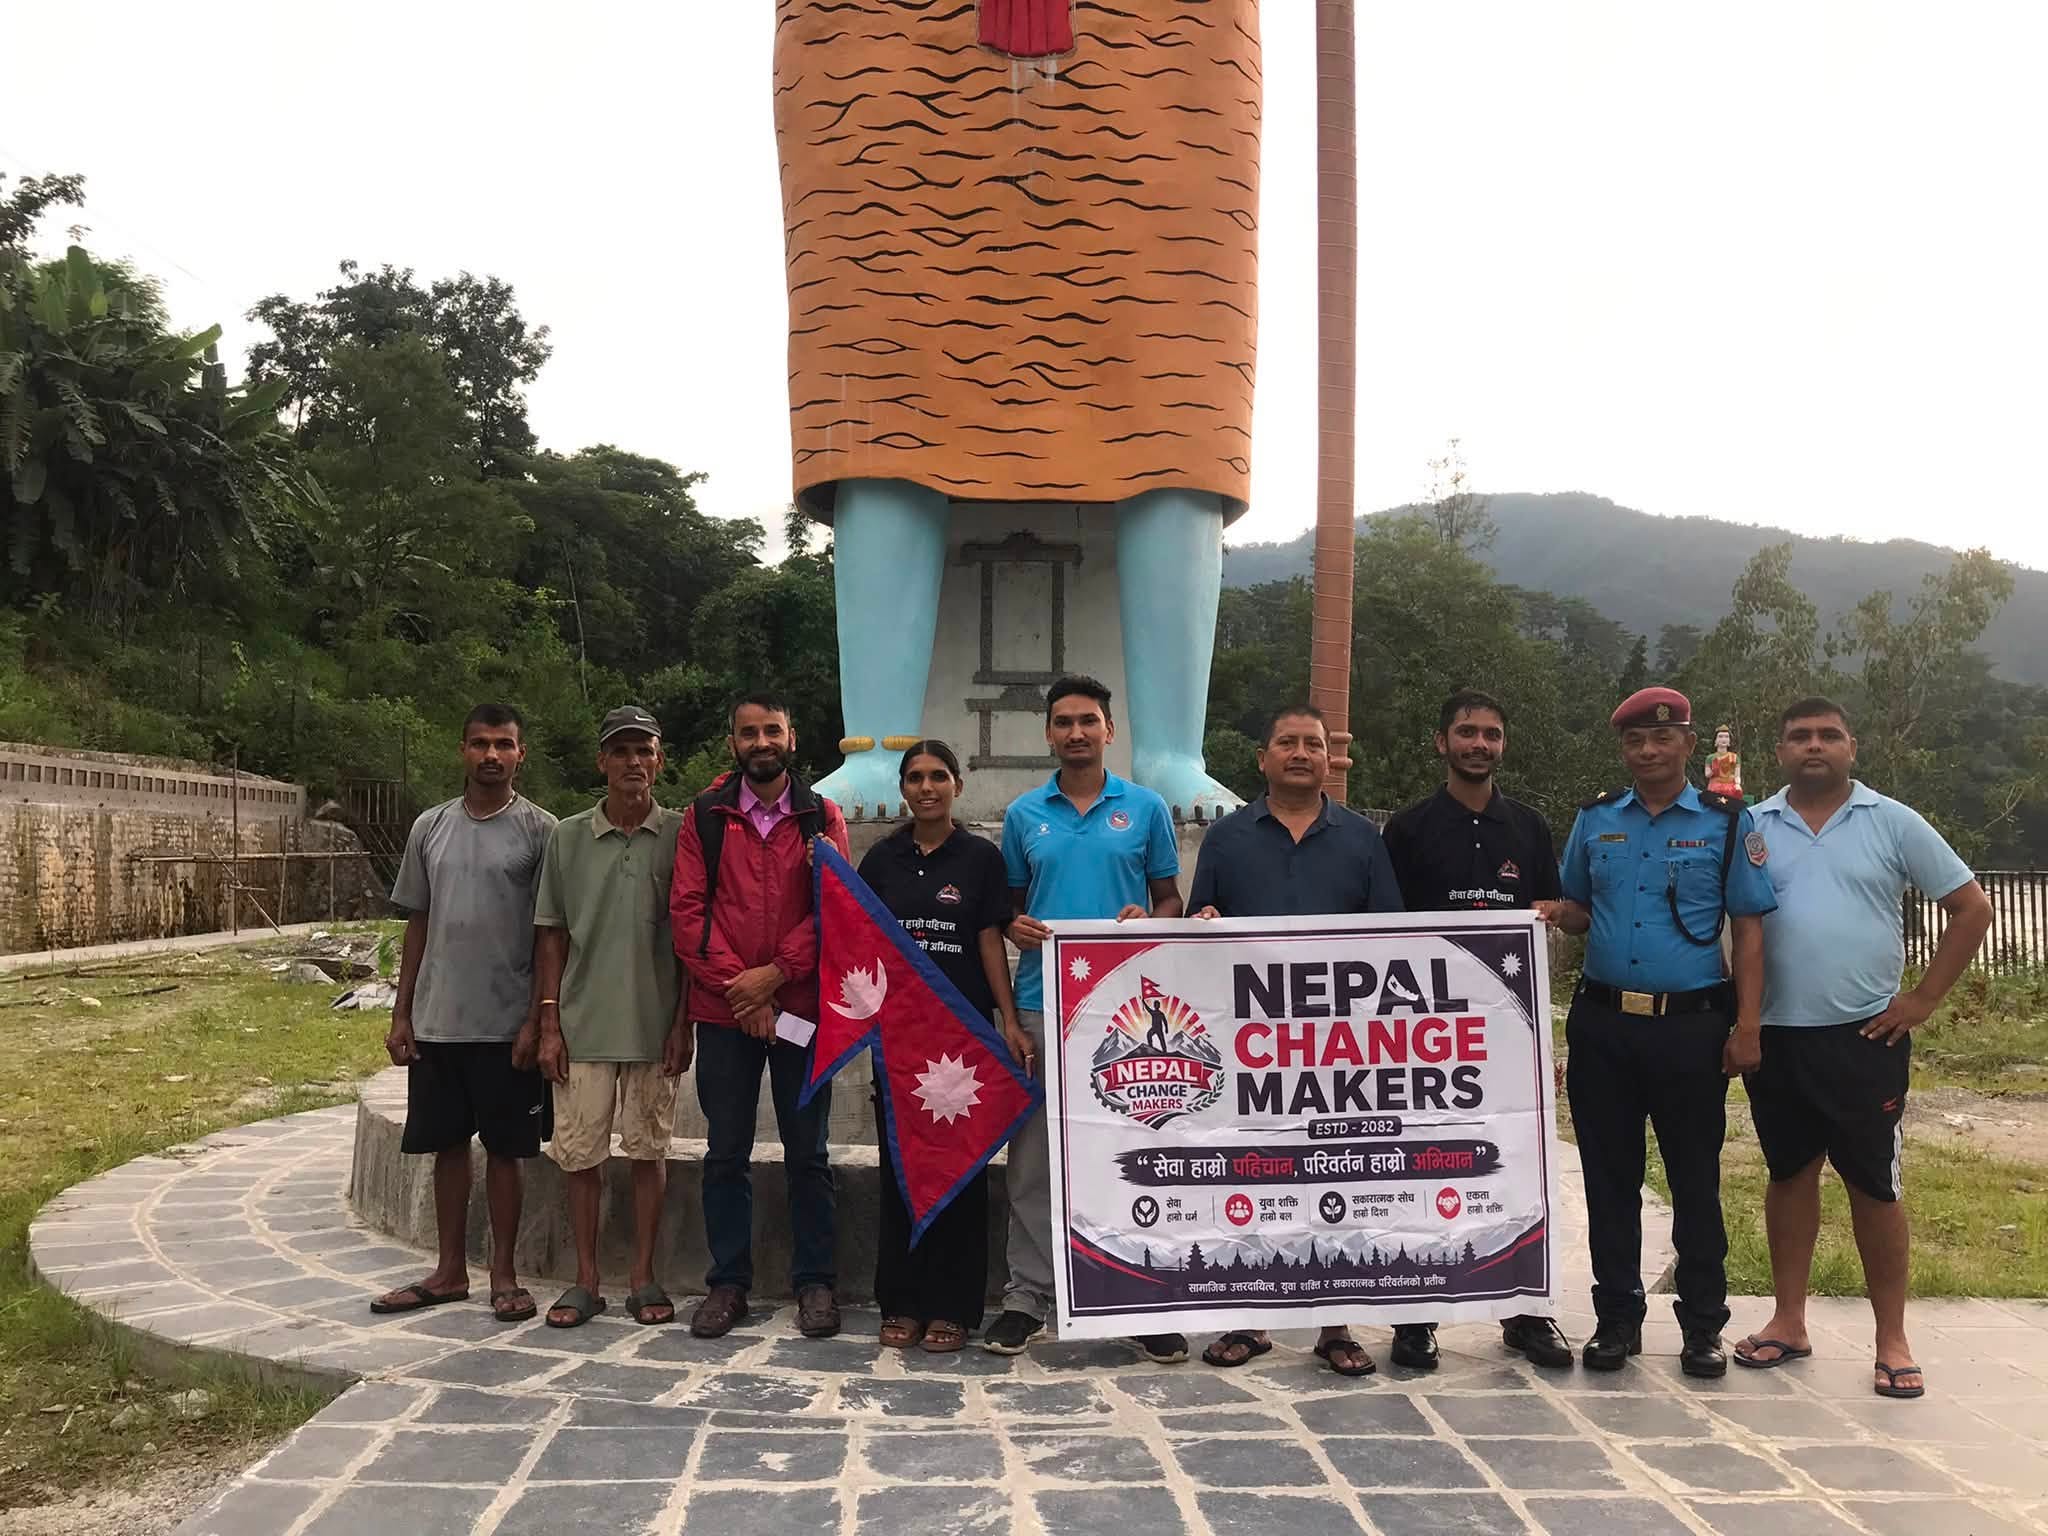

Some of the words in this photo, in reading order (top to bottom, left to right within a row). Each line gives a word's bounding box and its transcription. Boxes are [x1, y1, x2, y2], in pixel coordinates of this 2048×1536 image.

[1233, 958, 1469, 1019] NEPAL
[1234, 1016, 1488, 1069] CHANGE
[1116, 1060, 1198, 1082] NEPAL
[1127, 1084, 1188, 1098] CHANGE
[1236, 1065, 1484, 1115] MAKERS
[1132, 1099, 1183, 1111] MAKERS
[1315, 1123, 1348, 1136] ESTD
[1361, 1120, 1395, 1133] 2082
[1190, 1152, 1227, 1178] हाम्रो
[1303, 1149, 1364, 1175] परिवर्तन
[1370, 1148, 1406, 1173] हाम्रो
[1166, 1197, 1182, 1209] सेवा
[1466, 1191, 1490, 1201] एकता
[1259, 1198, 1275, 1211] युवा
[1188, 1281, 1227, 1293] सामाजिक
[1280, 1282, 1297, 1294] युवा
